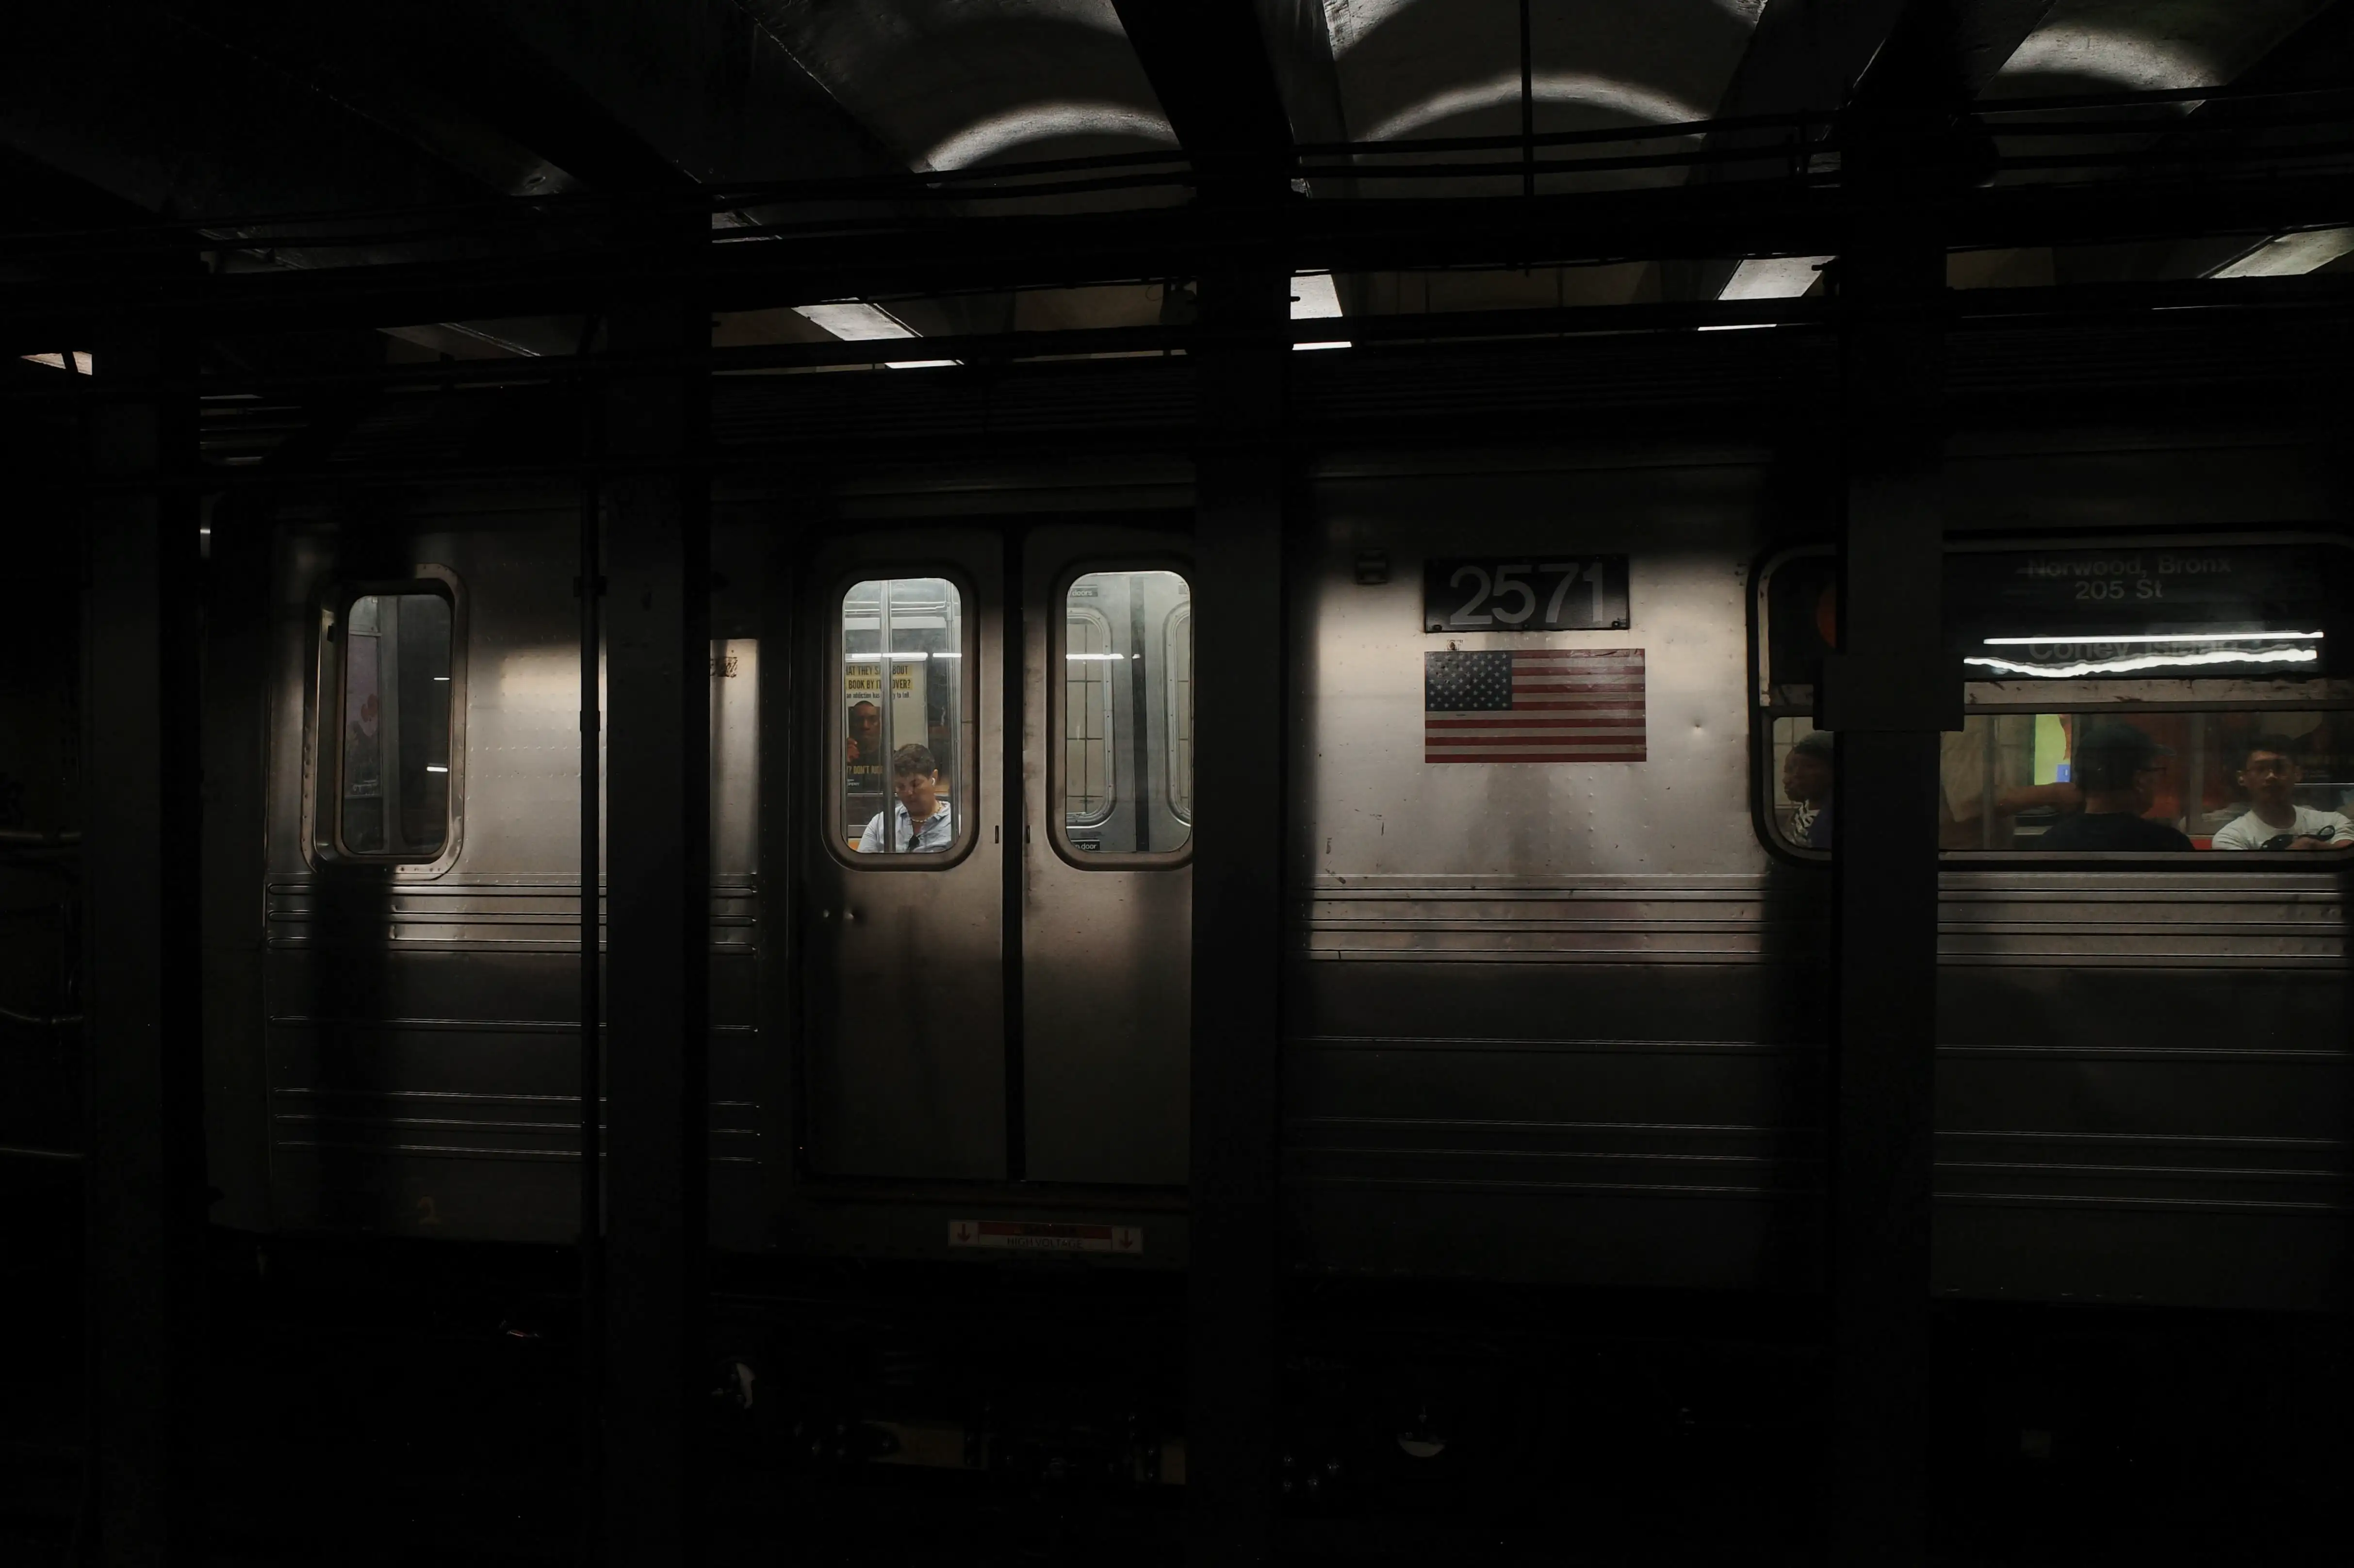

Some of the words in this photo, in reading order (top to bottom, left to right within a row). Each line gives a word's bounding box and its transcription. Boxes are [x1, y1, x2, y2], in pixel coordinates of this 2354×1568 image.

[2028, 555, 2147, 578] Norwood,
[2158, 555, 2233, 574] Bronx
[1449, 562, 1603, 624] 2571
[2074, 580, 2125, 600] 205
[2136, 578, 2163, 599] St
[857, 665, 872, 675] THEY
[893, 665, 908, 675] BOUT
[849, 680, 865, 689] BOOK
[866, 680, 874, 689] BY
[893, 679, 911, 688] OVER?
[853, 765, 869, 774] DON'T
[1007, 1237, 1033, 1247] HIGH
[1035, 1238, 1083, 1249] VOLTAGE
